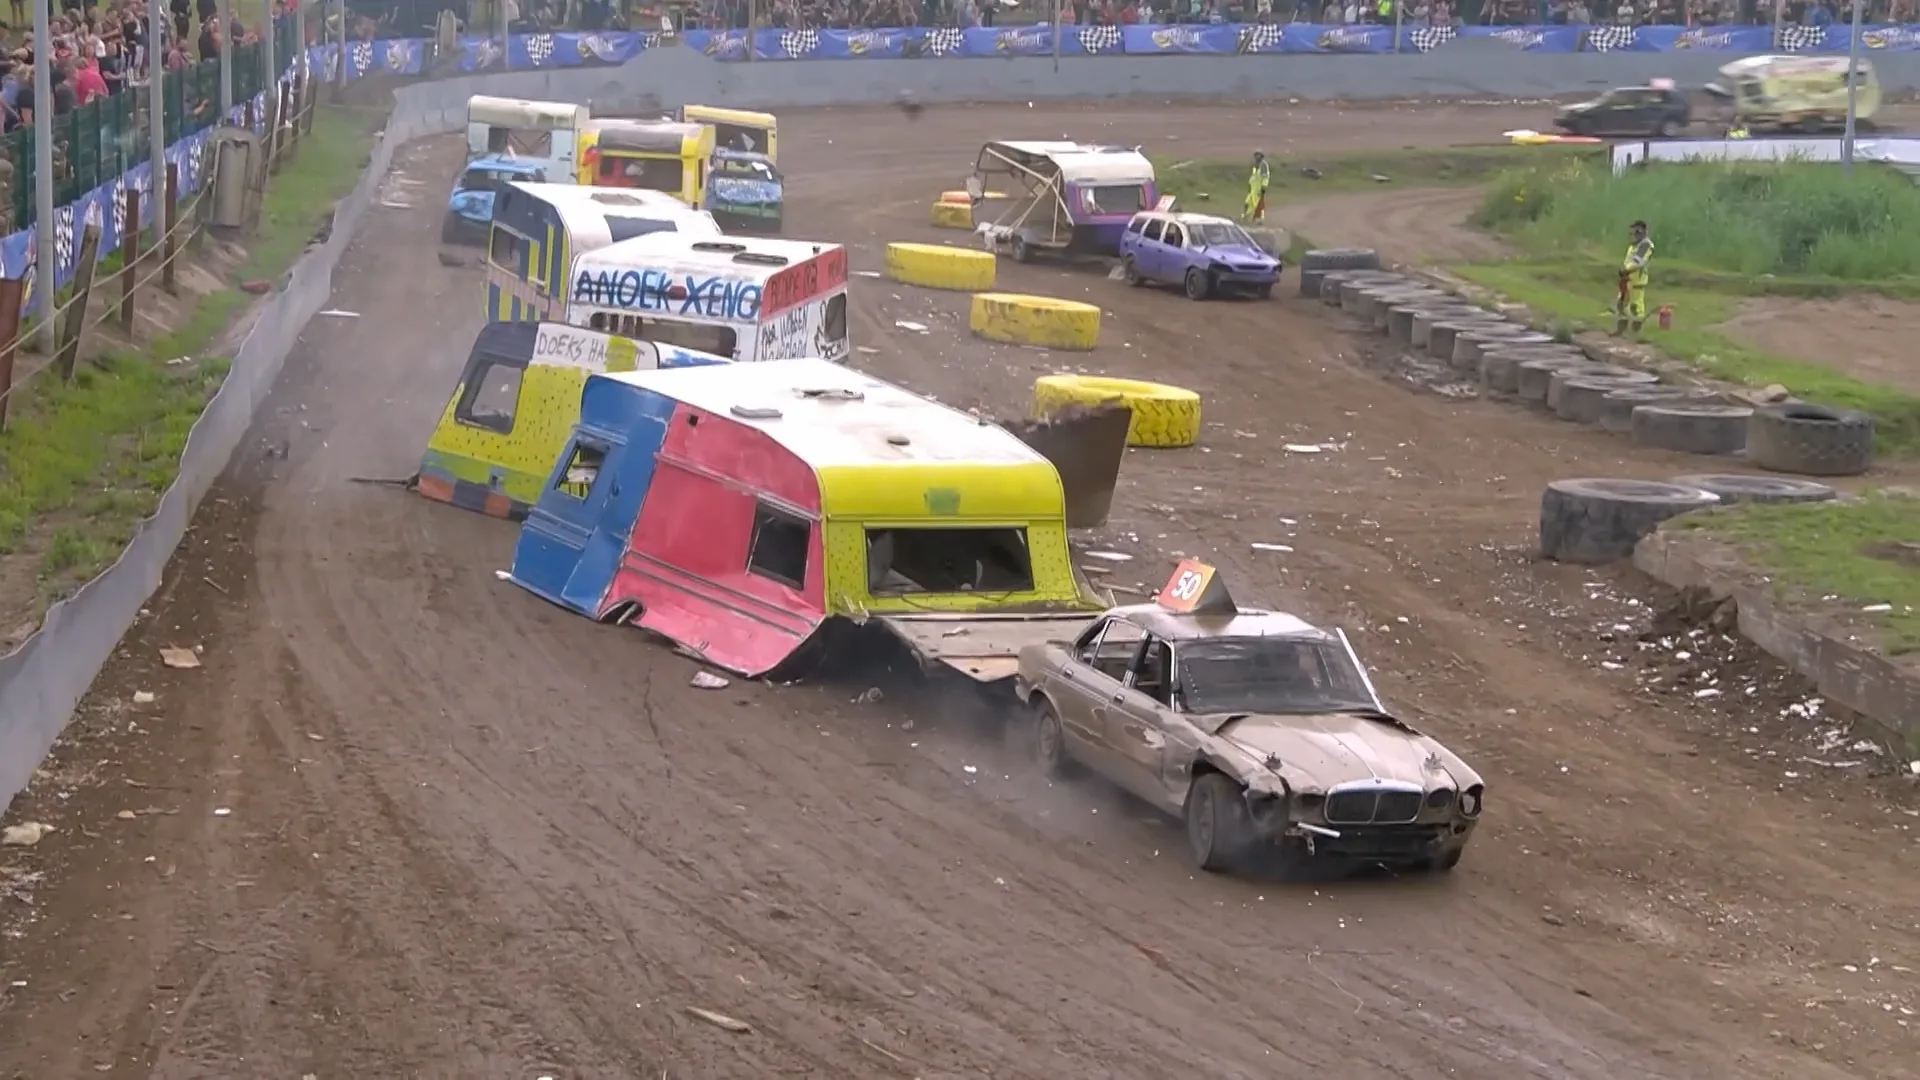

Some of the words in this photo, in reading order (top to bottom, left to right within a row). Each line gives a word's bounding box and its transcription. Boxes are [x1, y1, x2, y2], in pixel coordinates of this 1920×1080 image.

[574, 269, 672, 313] ANOEK
[679, 276, 761, 320] XENO
[536, 333, 585, 362] DOEKS
[1171, 570, 1202, 600] 50
